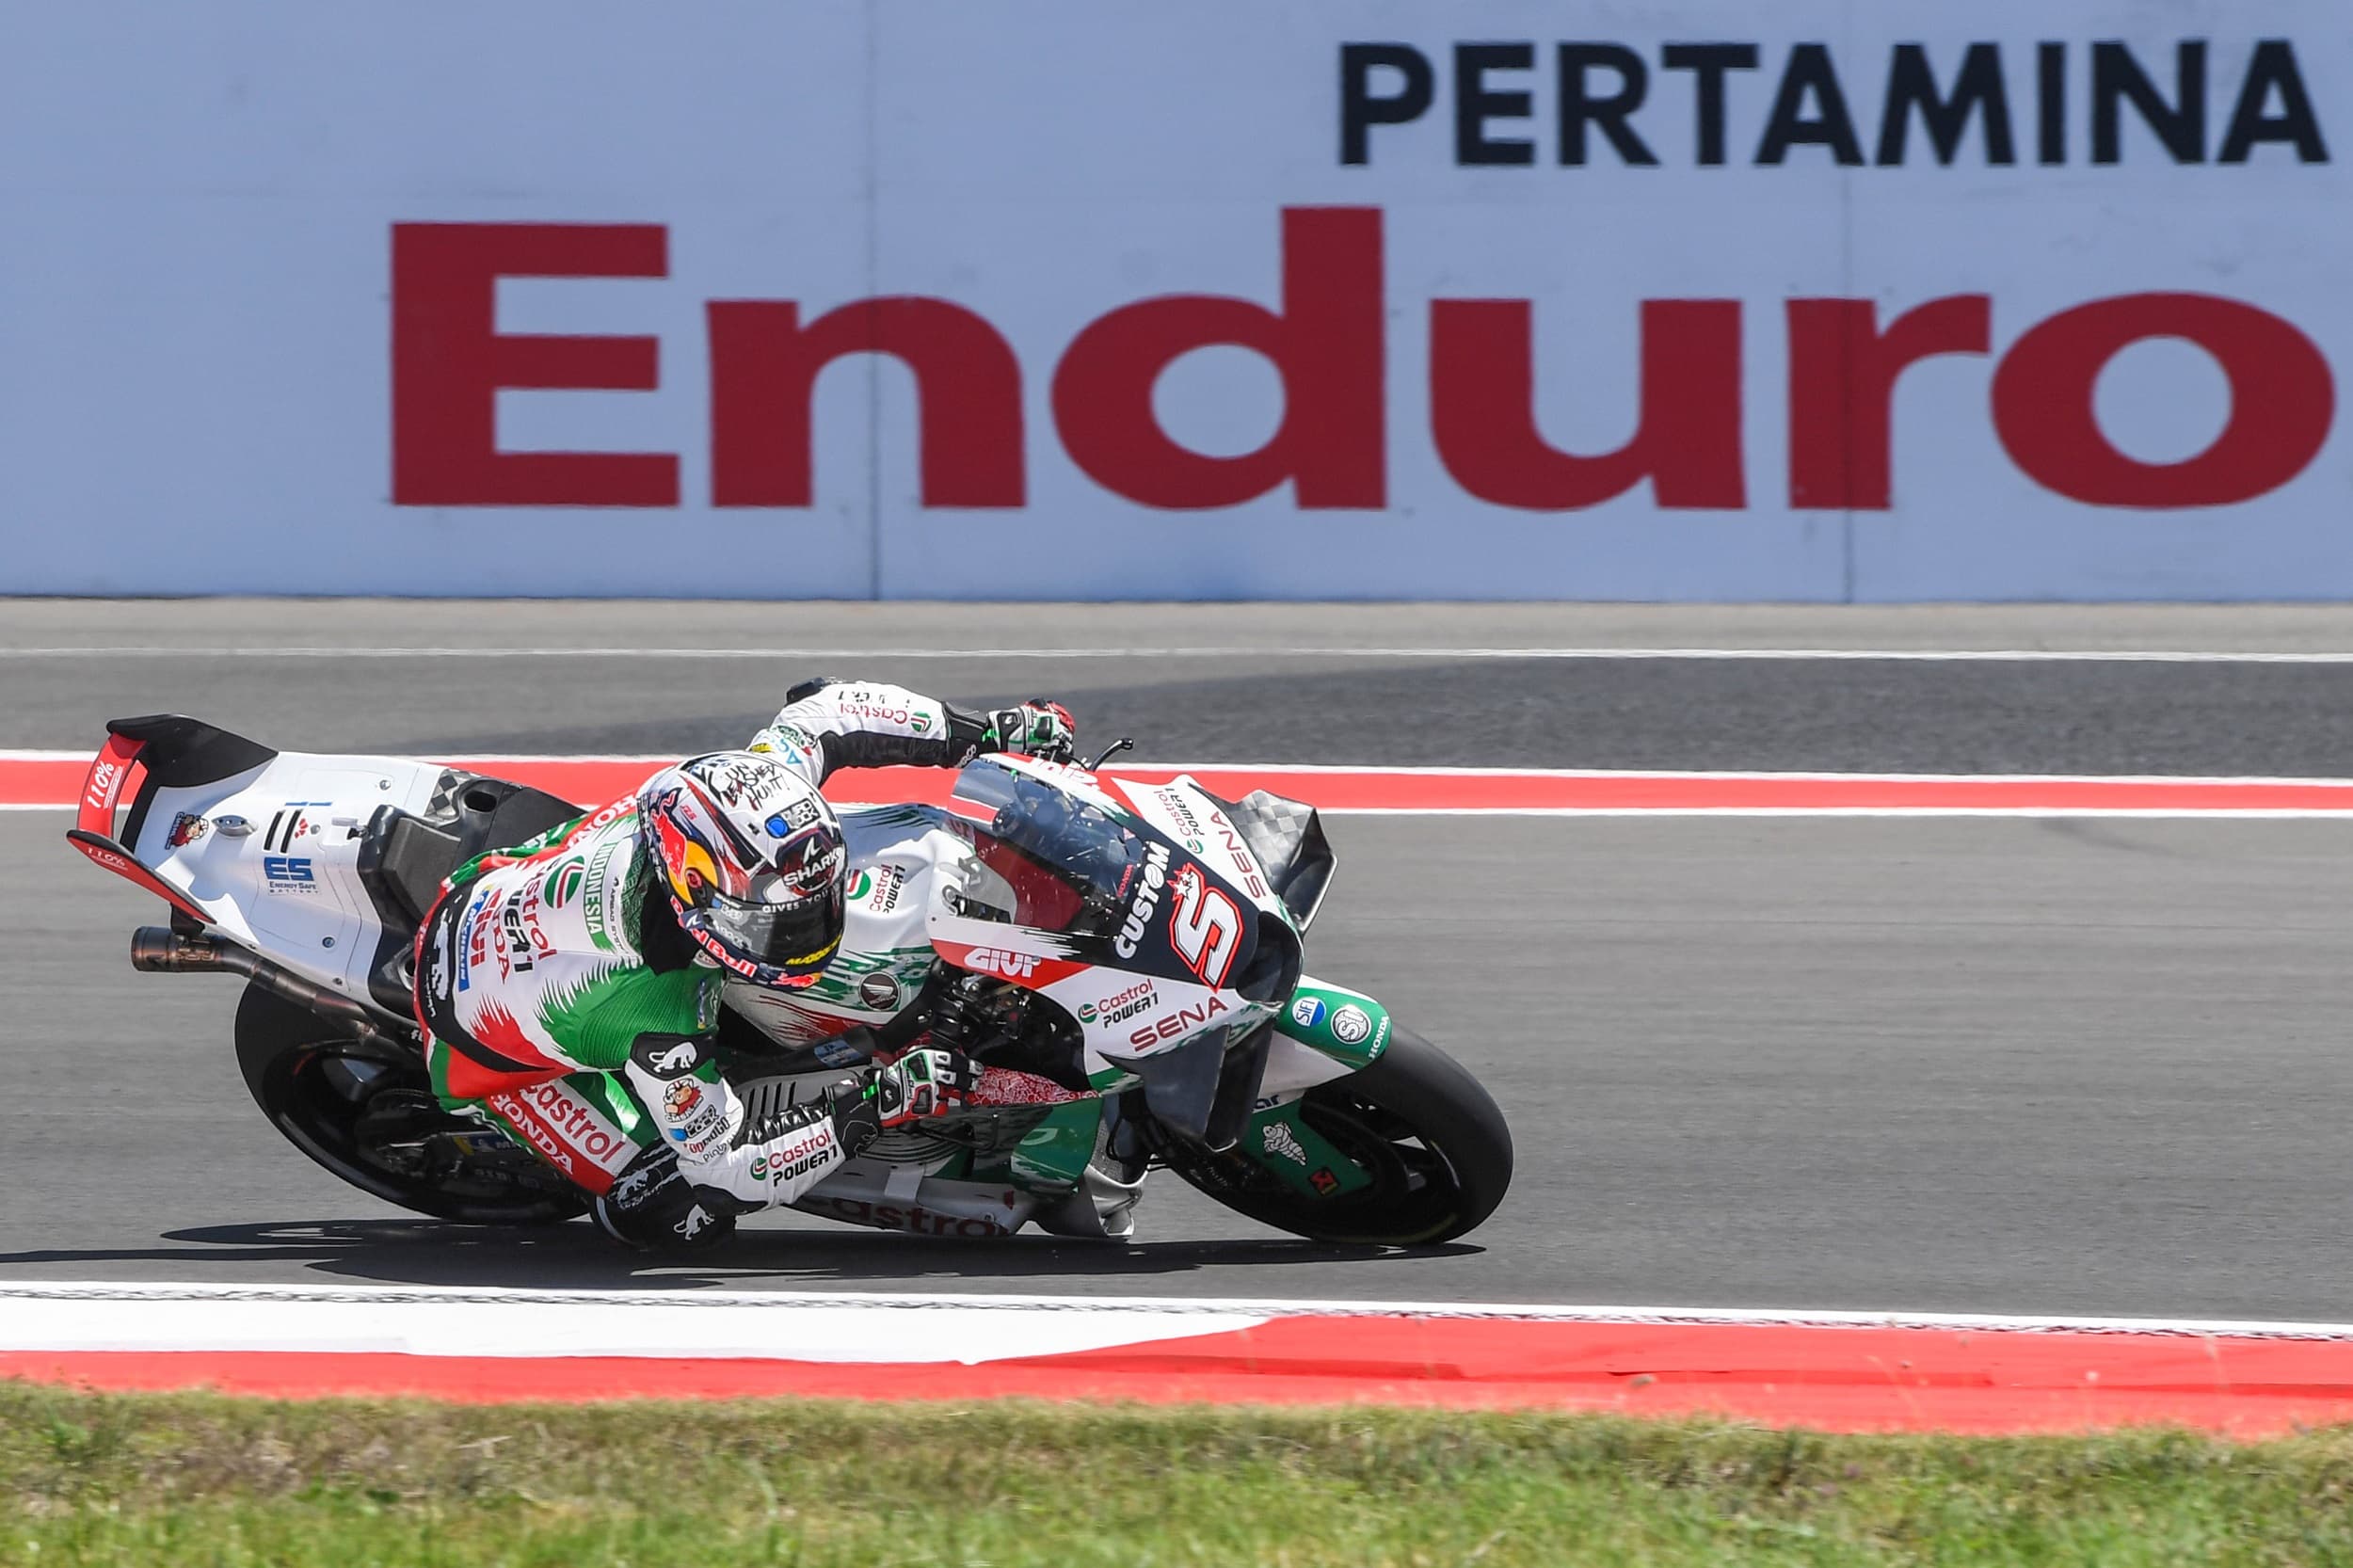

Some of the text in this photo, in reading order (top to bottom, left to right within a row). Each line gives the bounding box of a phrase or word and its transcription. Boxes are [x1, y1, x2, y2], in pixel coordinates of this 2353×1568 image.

[1341, 41, 2328, 166] PERTAMINA
[392, 207, 2334, 510] Enduro
[87, 760, 114, 808] 110%
[1154, 791, 1191, 837] Castrol
[1165, 788, 1205, 836] POWER1
[264, 856, 314, 881] ES
[783, 848, 841, 888] SHARK
[1210, 811, 1266, 899] SENA
[584, 843, 617, 935] INDONESIA
[762, 901, 800, 914] GIVES
[870, 864, 892, 912] Castrol
[883, 865, 905, 913] POWER1
[1115, 840, 1171, 959] CUSTOM
[1167, 862, 1244, 994] 5
[707, 939, 758, 979] Bull
[964, 947, 1043, 979] GIVI
[1098, 978, 1154, 1014] Castrol
[1103, 992, 1160, 1029] POWER1
[1130, 996, 1228, 1052] SENA
[1369, 1016, 1389, 1060] HONDA
[523, 1082, 626, 1164] astrol
[769, 1129, 832, 1169] Castrol
[773, 1147, 839, 1188] POWER1
